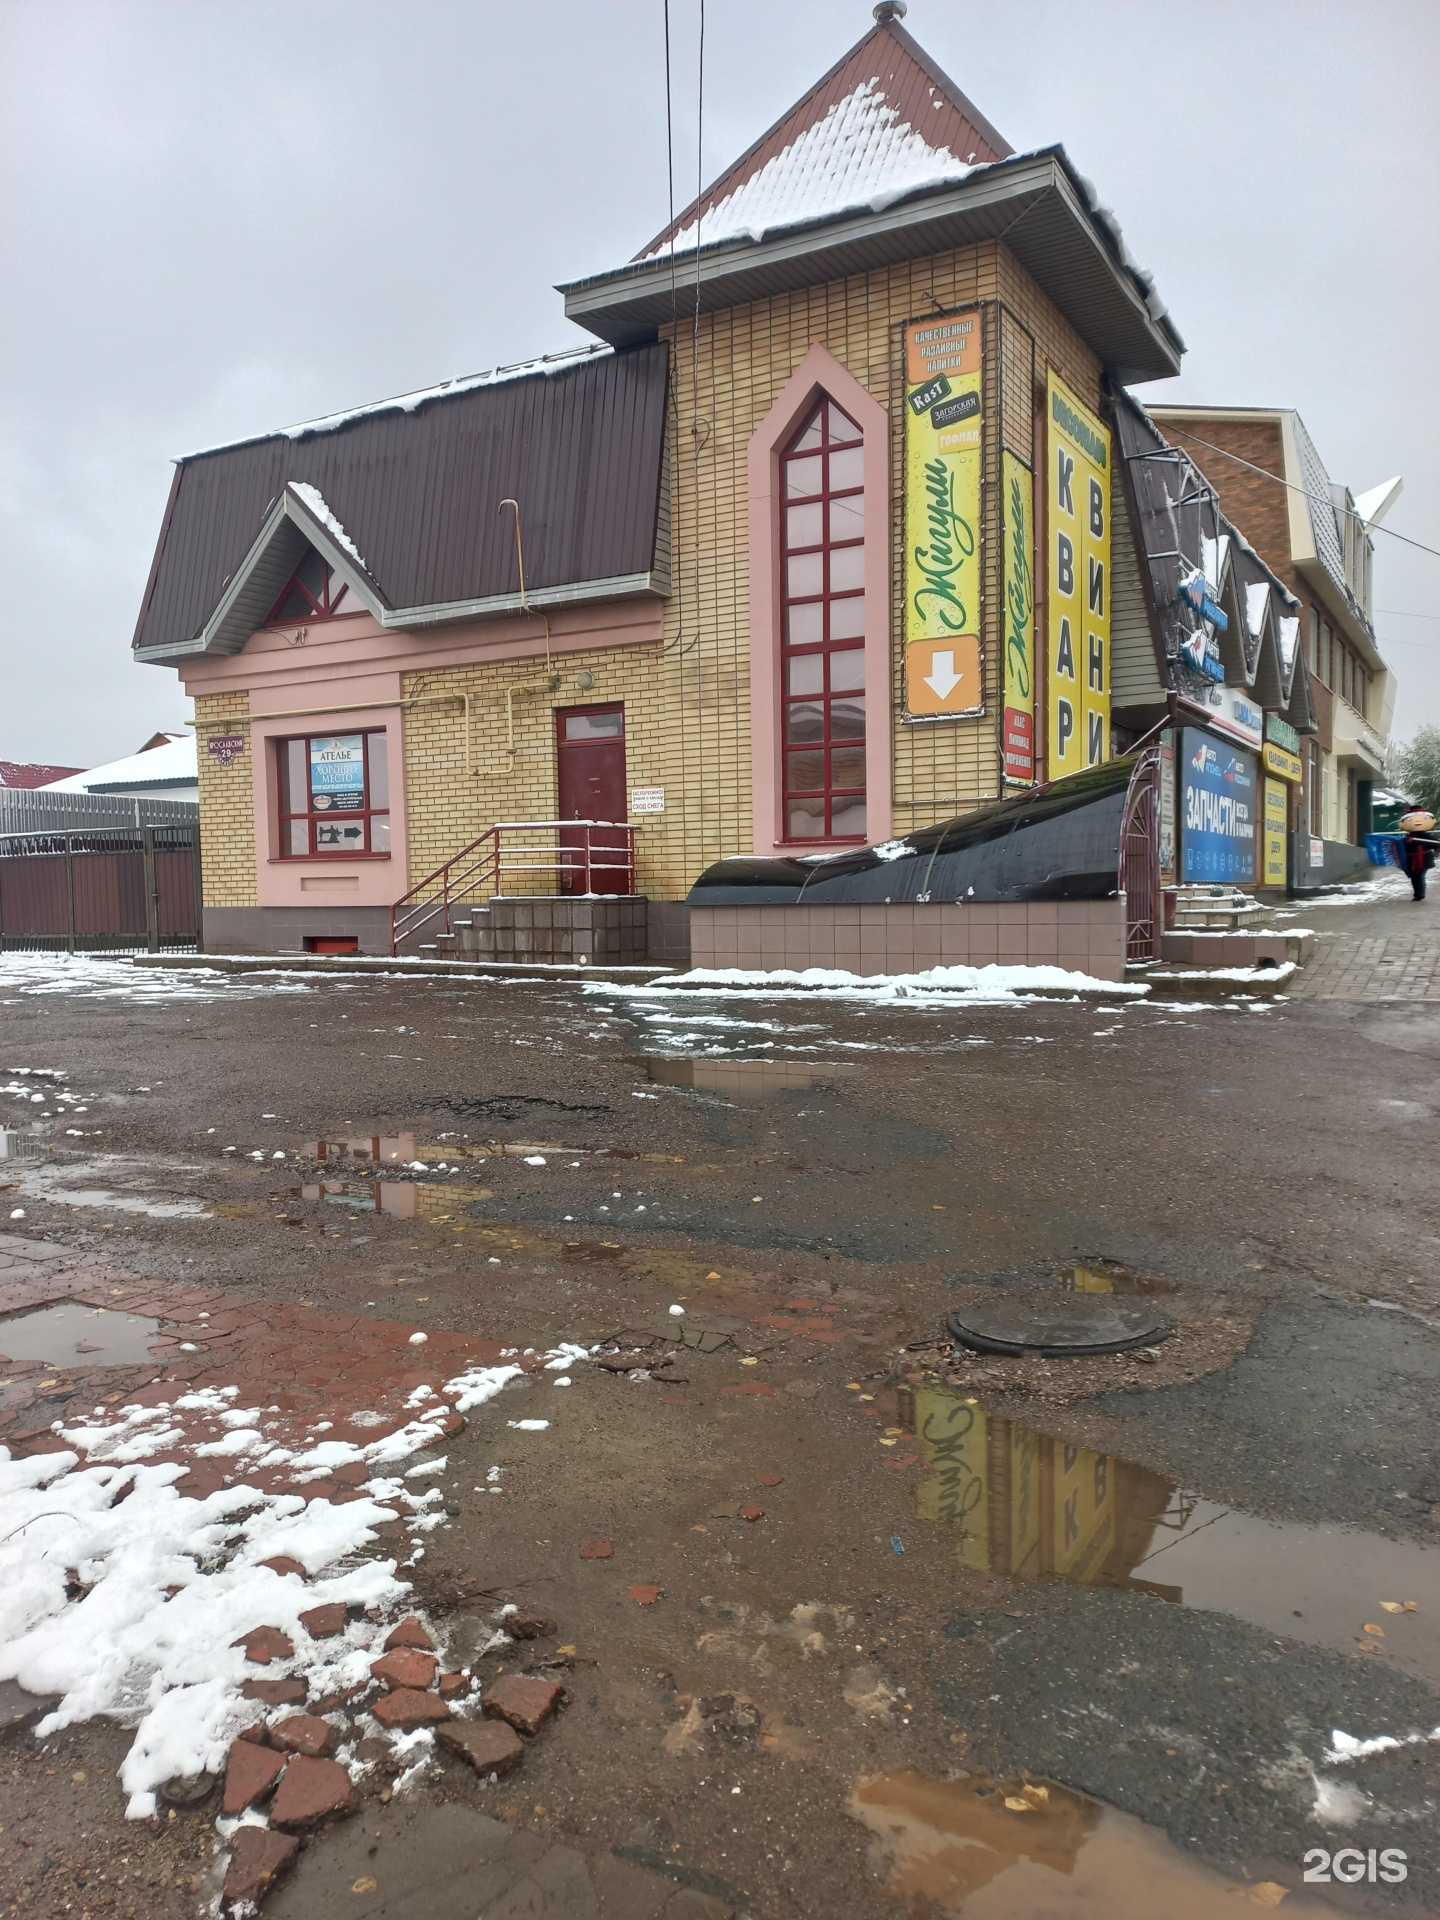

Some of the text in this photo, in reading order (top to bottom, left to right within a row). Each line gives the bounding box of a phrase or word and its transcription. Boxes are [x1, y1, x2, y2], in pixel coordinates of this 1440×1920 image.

[915, 320, 973, 344] КАЧЕСТВЕННЫЕ
[927, 356, 961, 373] НАПИТКИ
[935, 397, 977, 421] ЗАГОРСКАЯ
[914, 458, 974, 630] Жигули
[1008, 477, 1033, 699] Жигули
[320, 750, 352, 761] АТЕЛЬЕ
[322, 773, 353, 784] МЕСТО
[1186, 785, 1236, 838] ЗАПЧАСТИ
